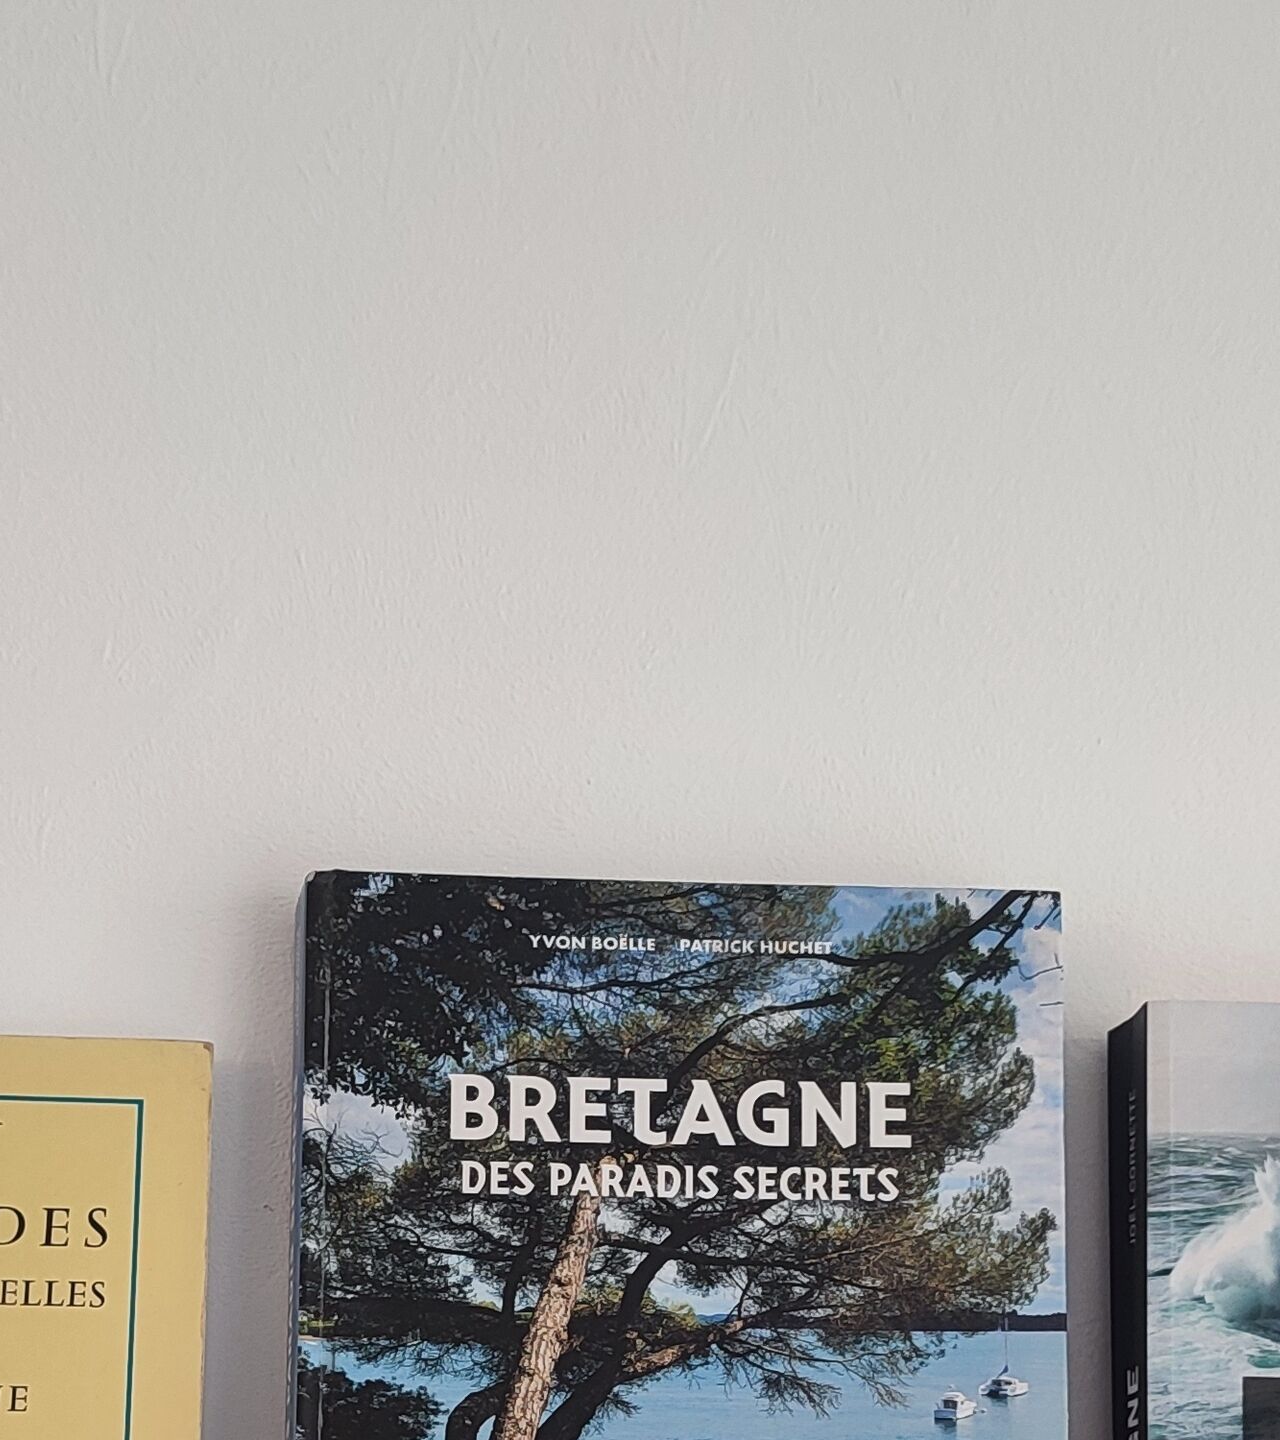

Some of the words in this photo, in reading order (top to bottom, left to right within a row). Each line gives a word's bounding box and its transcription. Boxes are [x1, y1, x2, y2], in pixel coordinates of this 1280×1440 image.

[528, 934, 586, 949] YVON
[591, 934, 656, 951] BOËLLE
[679, 938, 755, 954] PATRICK
[760, 940, 833, 954] HUCHET
[449, 1073, 912, 1149] BRETAGNE
[460, 1160, 535, 1196] DES
[549, 1162, 719, 1200] PARADIS
[732, 1166, 900, 1202] SECRETS
